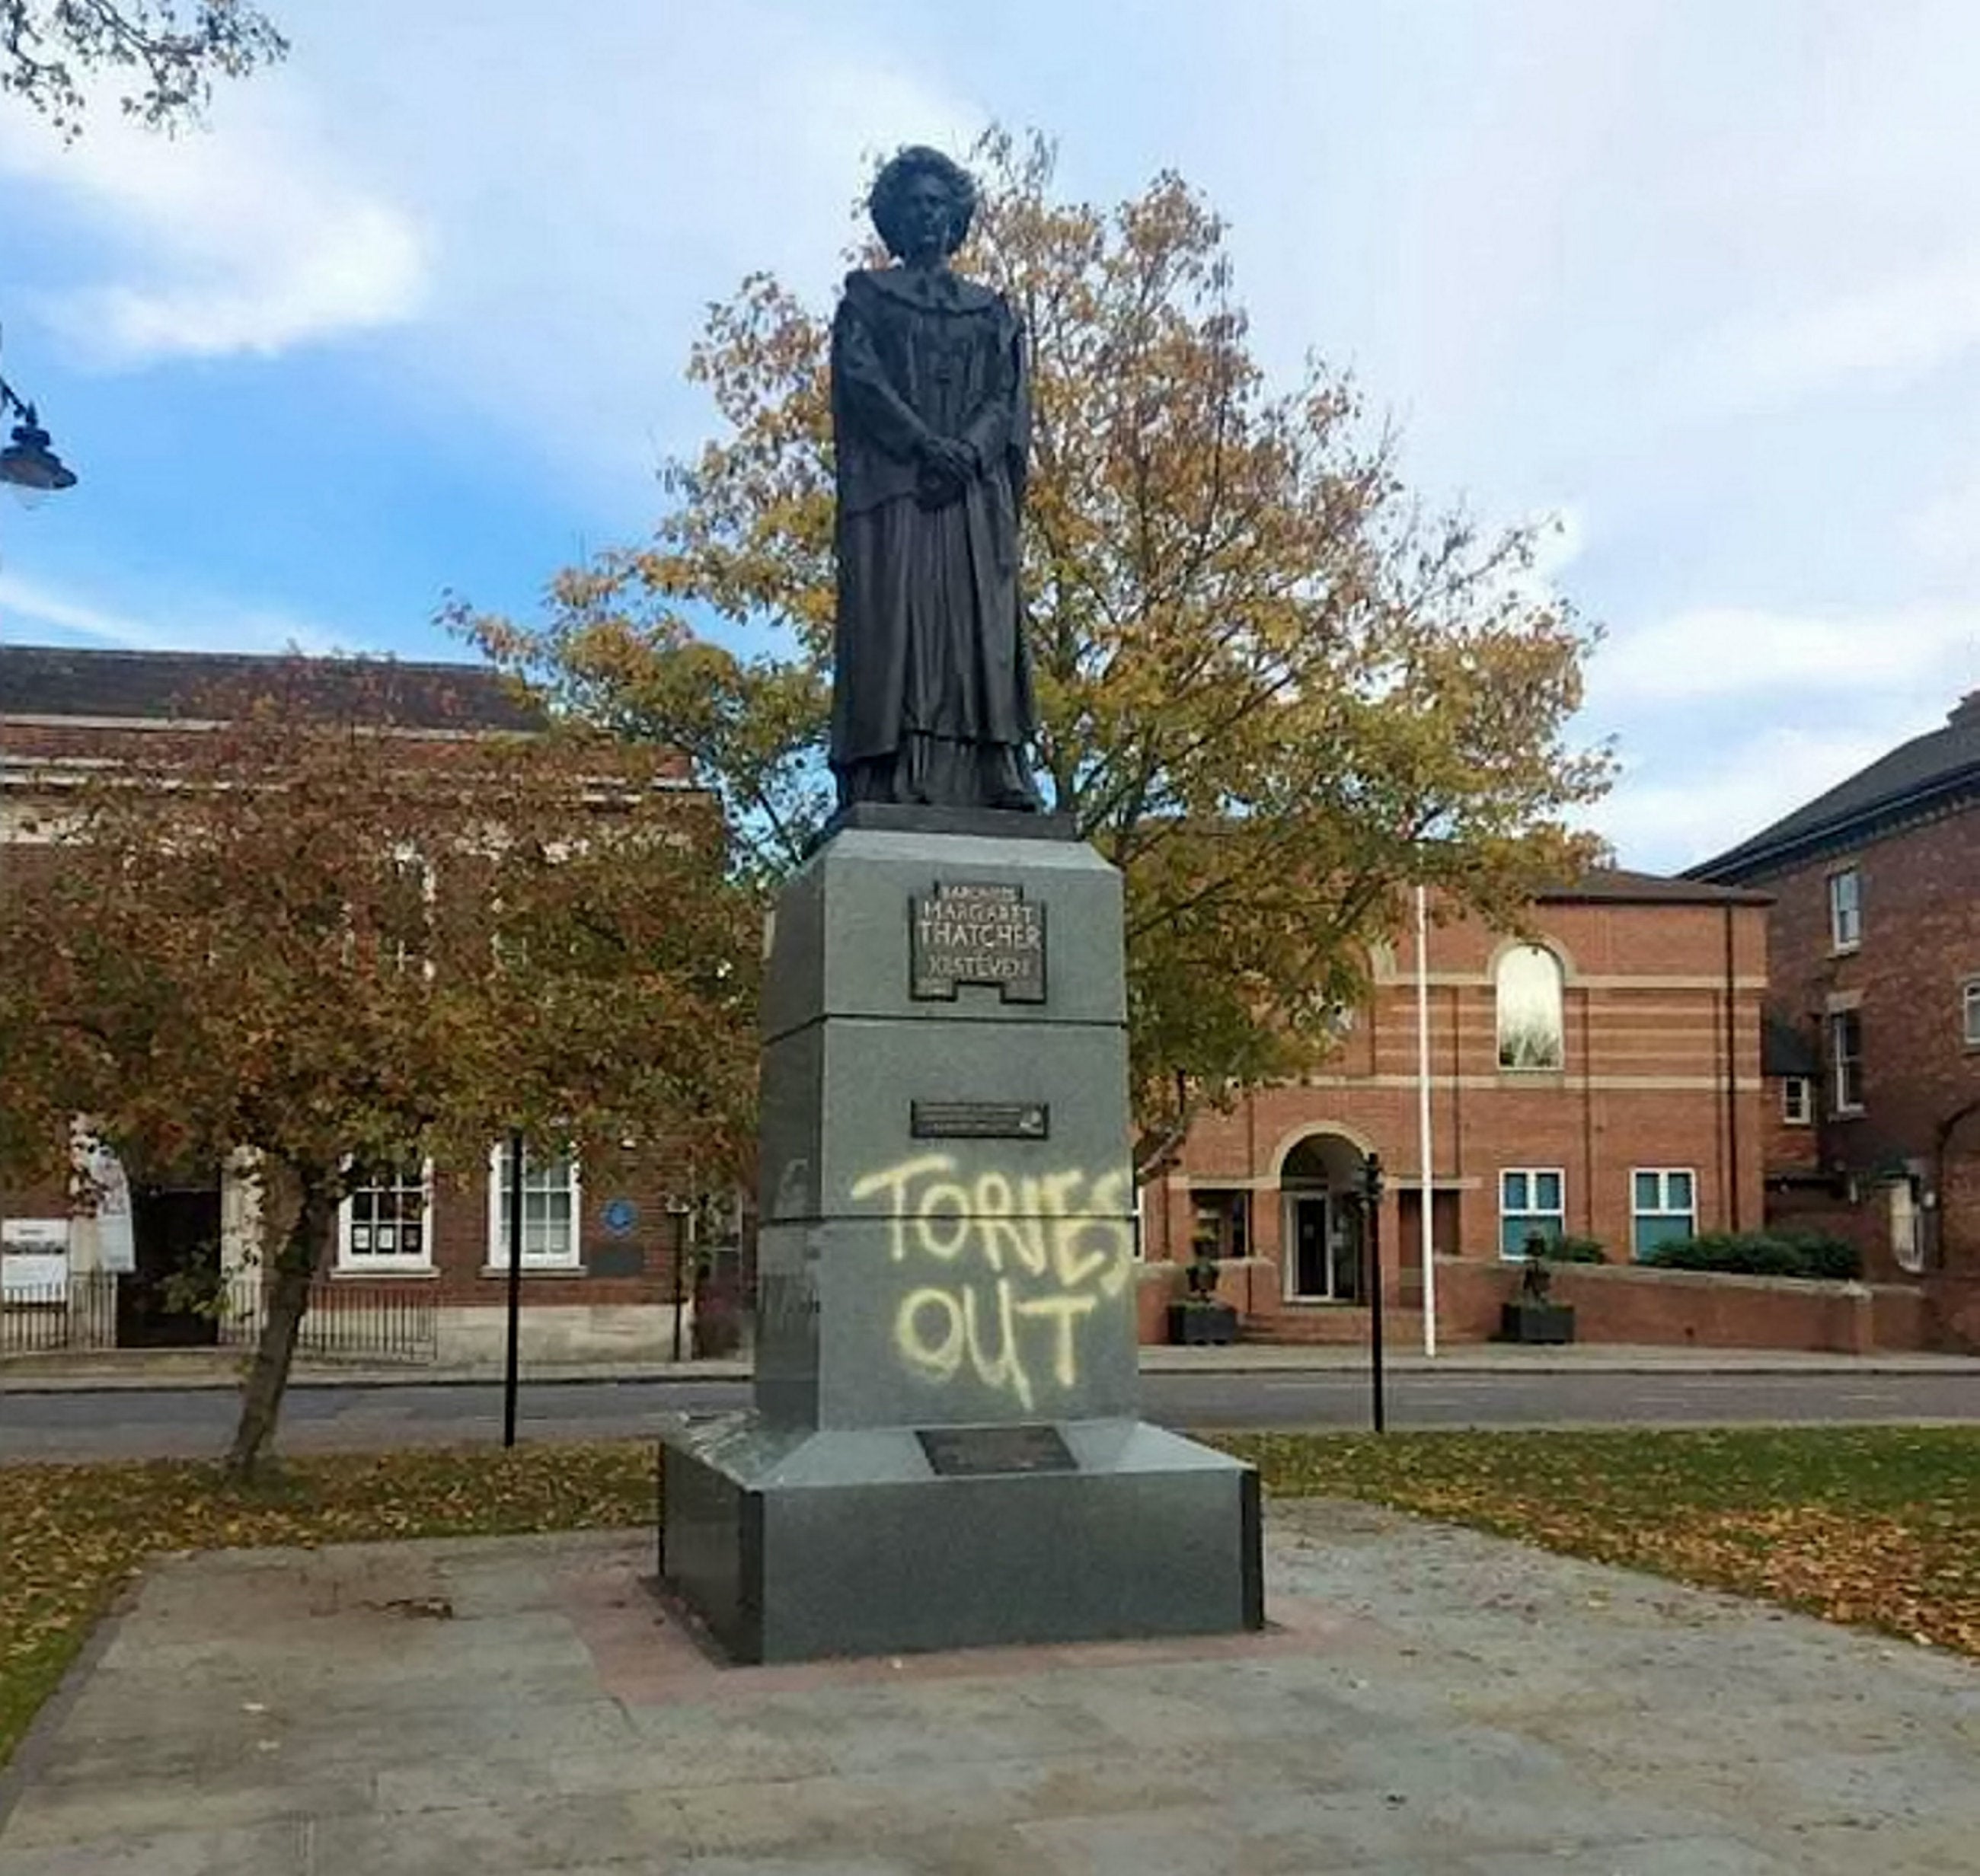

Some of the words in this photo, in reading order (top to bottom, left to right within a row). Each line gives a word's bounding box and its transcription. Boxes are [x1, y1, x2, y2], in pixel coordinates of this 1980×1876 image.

[918, 920, 1043, 951] THATCHER
[851, 1153, 1133, 1295] TORIES
[896, 1277, 1097, 1411] OUT
